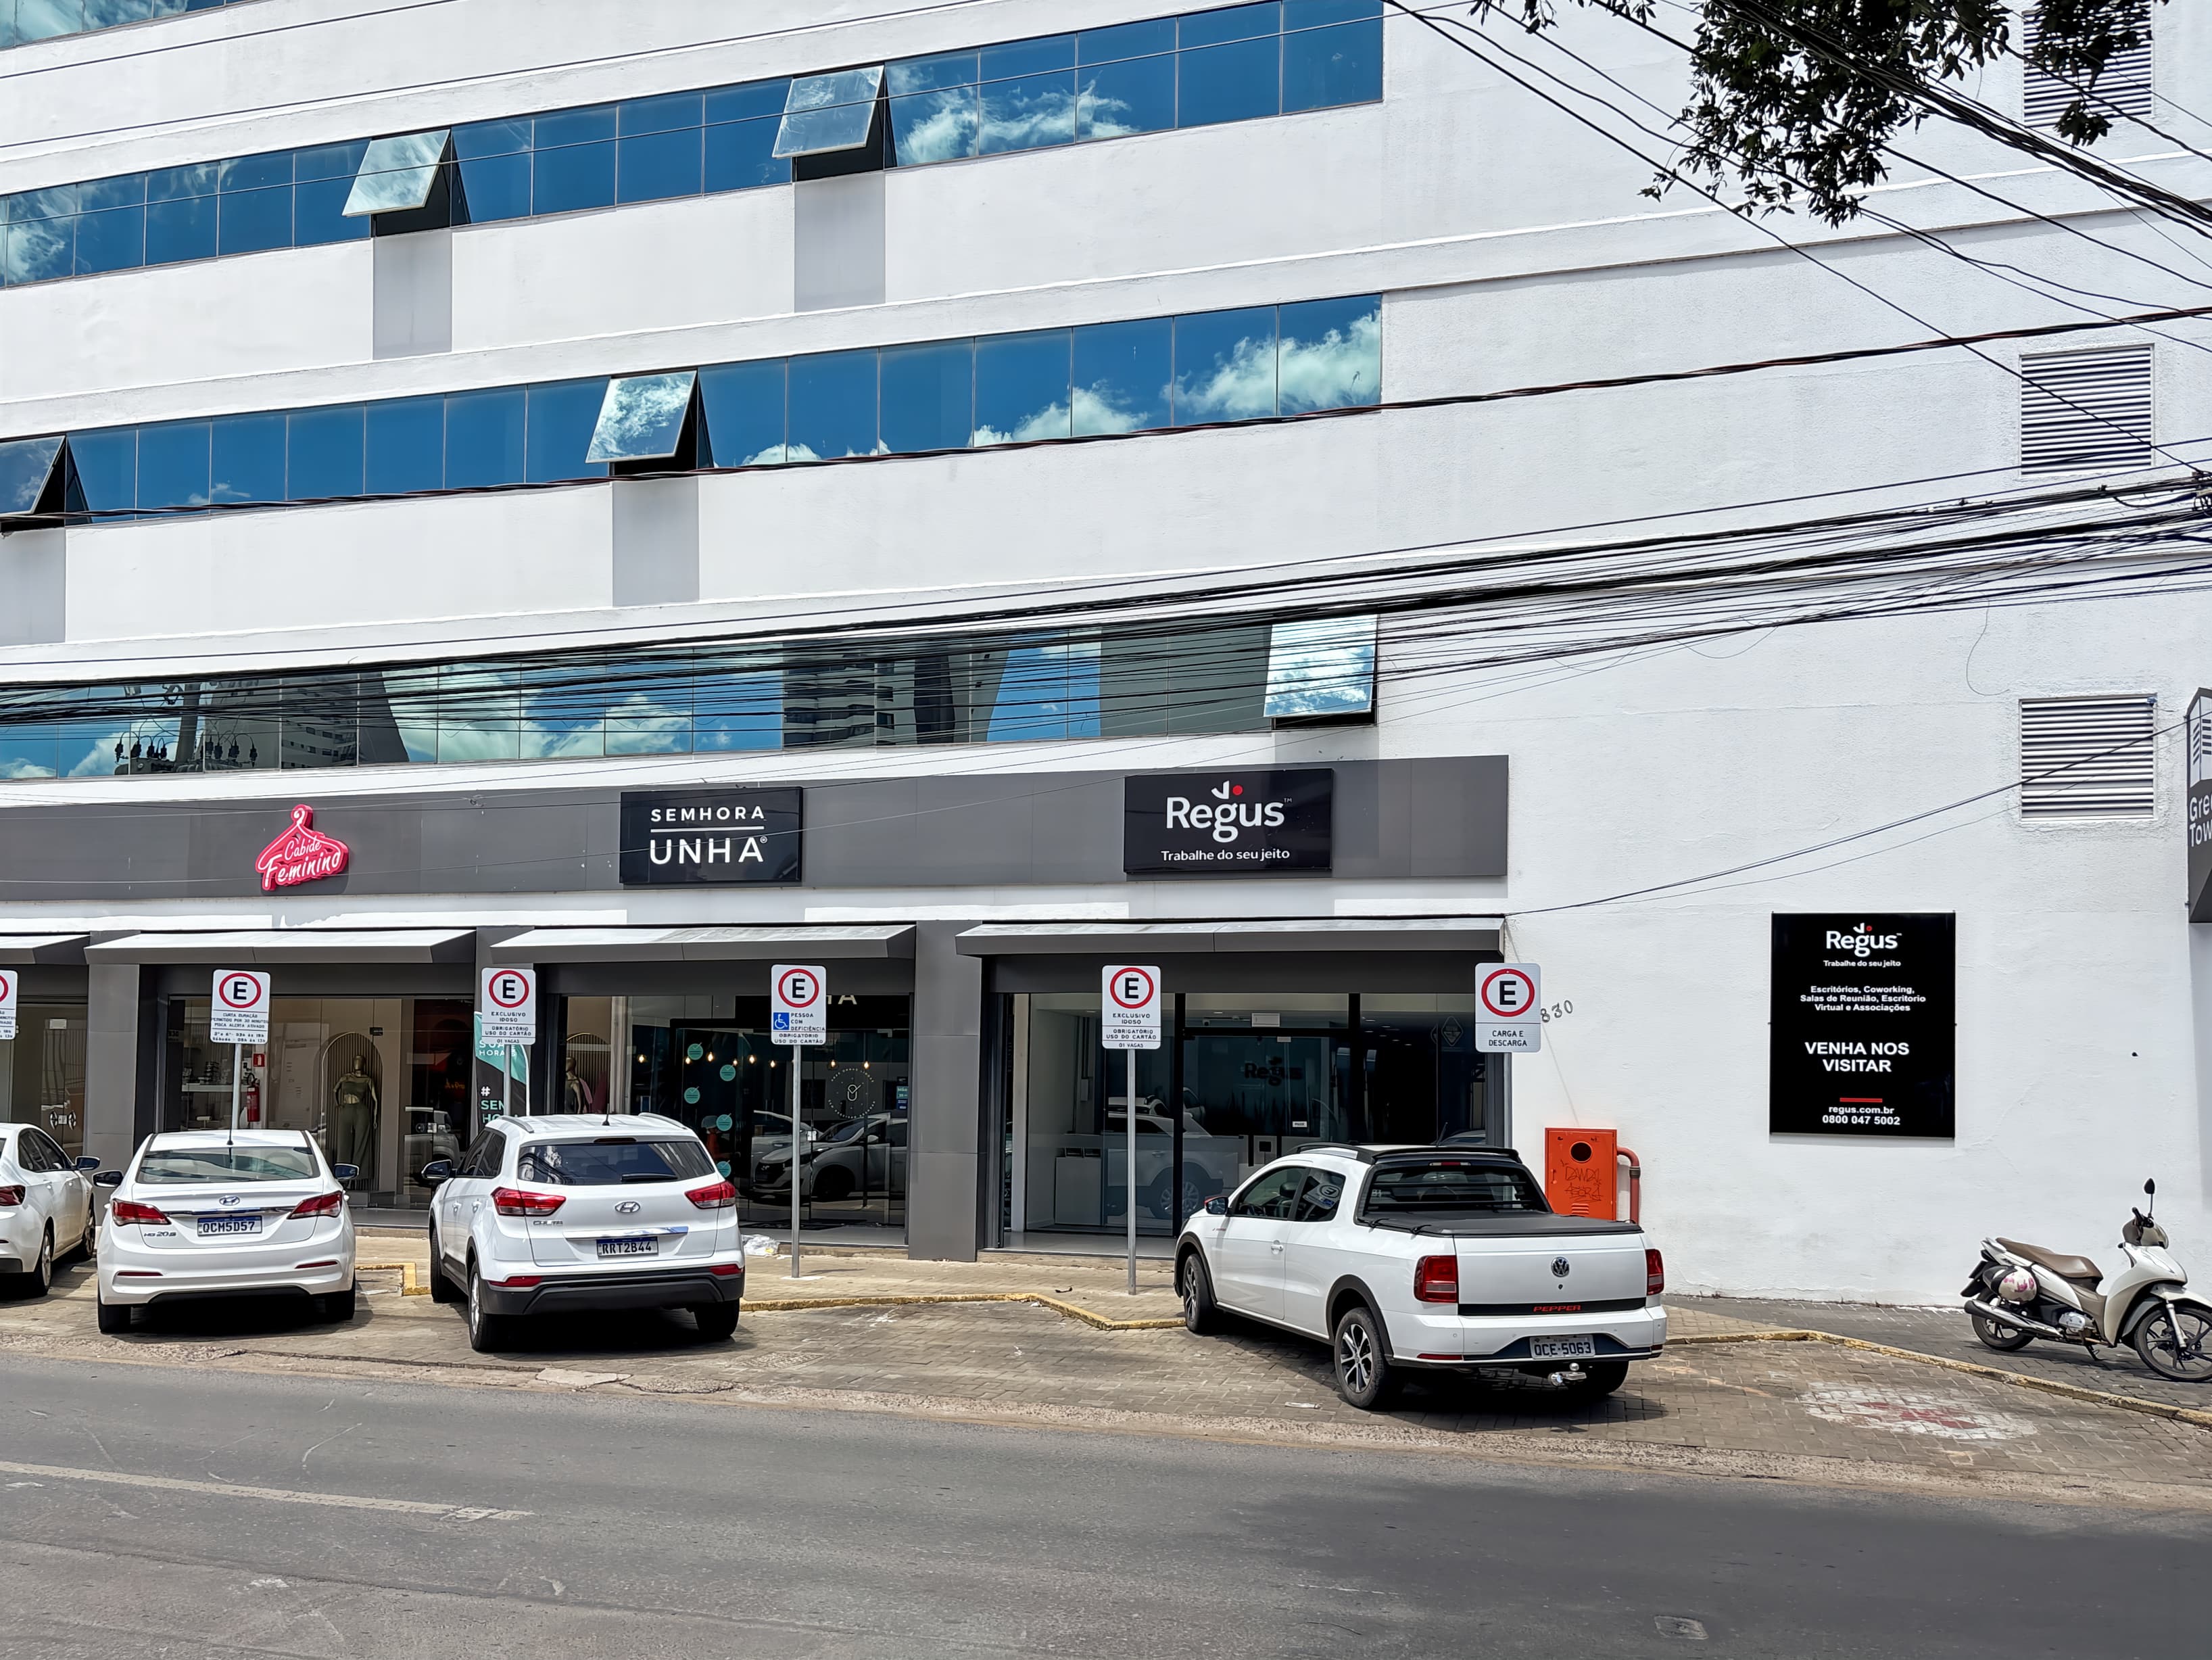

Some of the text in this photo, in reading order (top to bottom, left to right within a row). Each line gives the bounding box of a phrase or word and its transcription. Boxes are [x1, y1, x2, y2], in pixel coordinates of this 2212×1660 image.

[650, 805, 765, 822] SEMHORA
[285, 834, 322, 861] Cabide
[1161, 849, 1290, 861] Trabalhe do seu jeito
[264, 851, 341, 888] Feminino
[233, 981, 247, 1000] E
[503, 979, 516, 999] E
[792, 978, 805, 999] E
[1124, 977, 1139, 999] E
[1499, 980, 1516, 1005] E
[1810, 985, 1915, 995] Escritórios, Coworking,
[1840, 995, 1879, 1003] Reunião,
[1881, 995, 1926, 1003] Escritorio
[1540, 1000, 1573, 1023] 830
[1814, 1003, 1844, 1012] Virtual
[1853, 1003, 1910, 1012] Associações
[1804, 1042, 1910, 1056] VENHA NOS
[1823, 1059, 1892, 1072] VISITAR
[1829, 1106, 1894, 1114] regus.com.br
[1823, 1114, 1900, 1125] 0800 047 5002
[602, 1241, 652, 1254] RRT2B44
